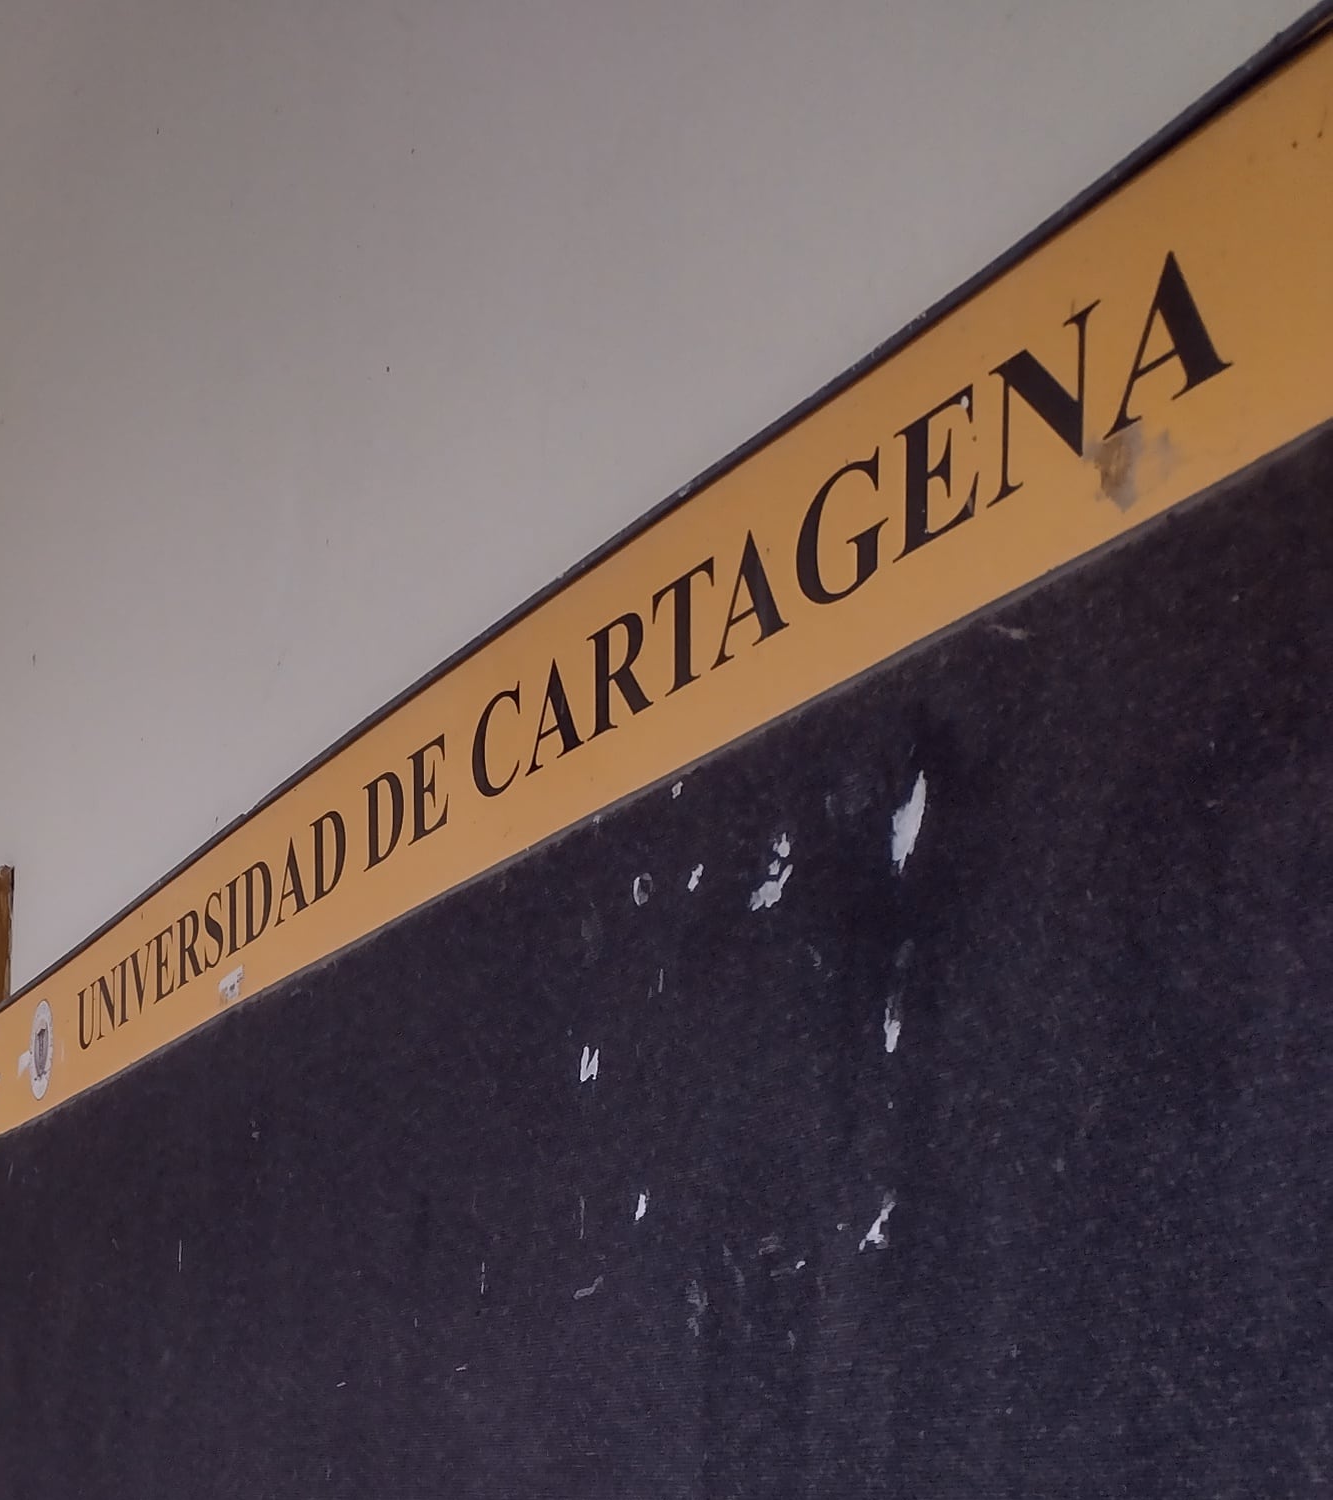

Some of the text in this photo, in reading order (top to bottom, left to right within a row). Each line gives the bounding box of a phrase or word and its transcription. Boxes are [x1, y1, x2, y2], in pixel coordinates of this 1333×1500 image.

[76, 251, 1235, 1051] UNIVERSIDAD DE CARTAGENA
